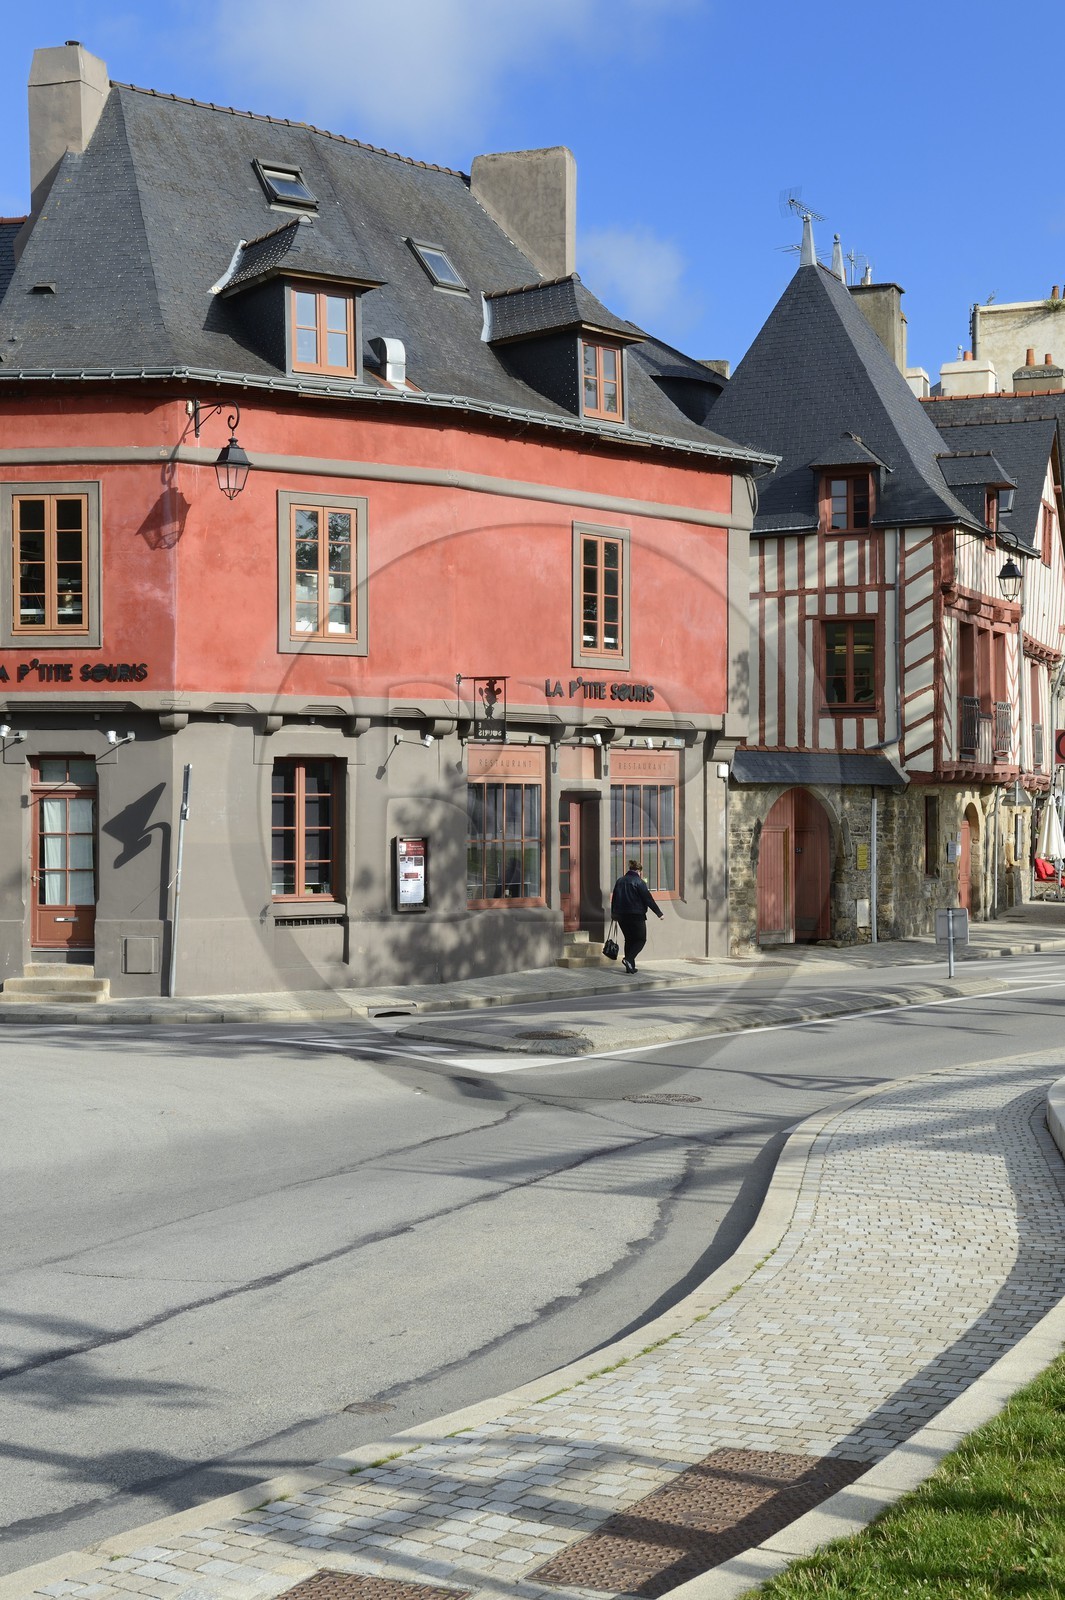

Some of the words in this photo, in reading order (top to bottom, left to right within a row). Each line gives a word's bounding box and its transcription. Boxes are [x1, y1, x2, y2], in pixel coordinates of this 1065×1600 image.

[17, 658, 73, 683] P'TITE
[80, 663, 148, 683] SOURIS
[545, 678, 565, 697] LA
[569, 676, 607, 700] P'TITE
[610, 683, 655, 702] SOURIS
[479, 758, 532, 768] RESTAURANT
[618, 762, 666, 770] RESTAURANT
